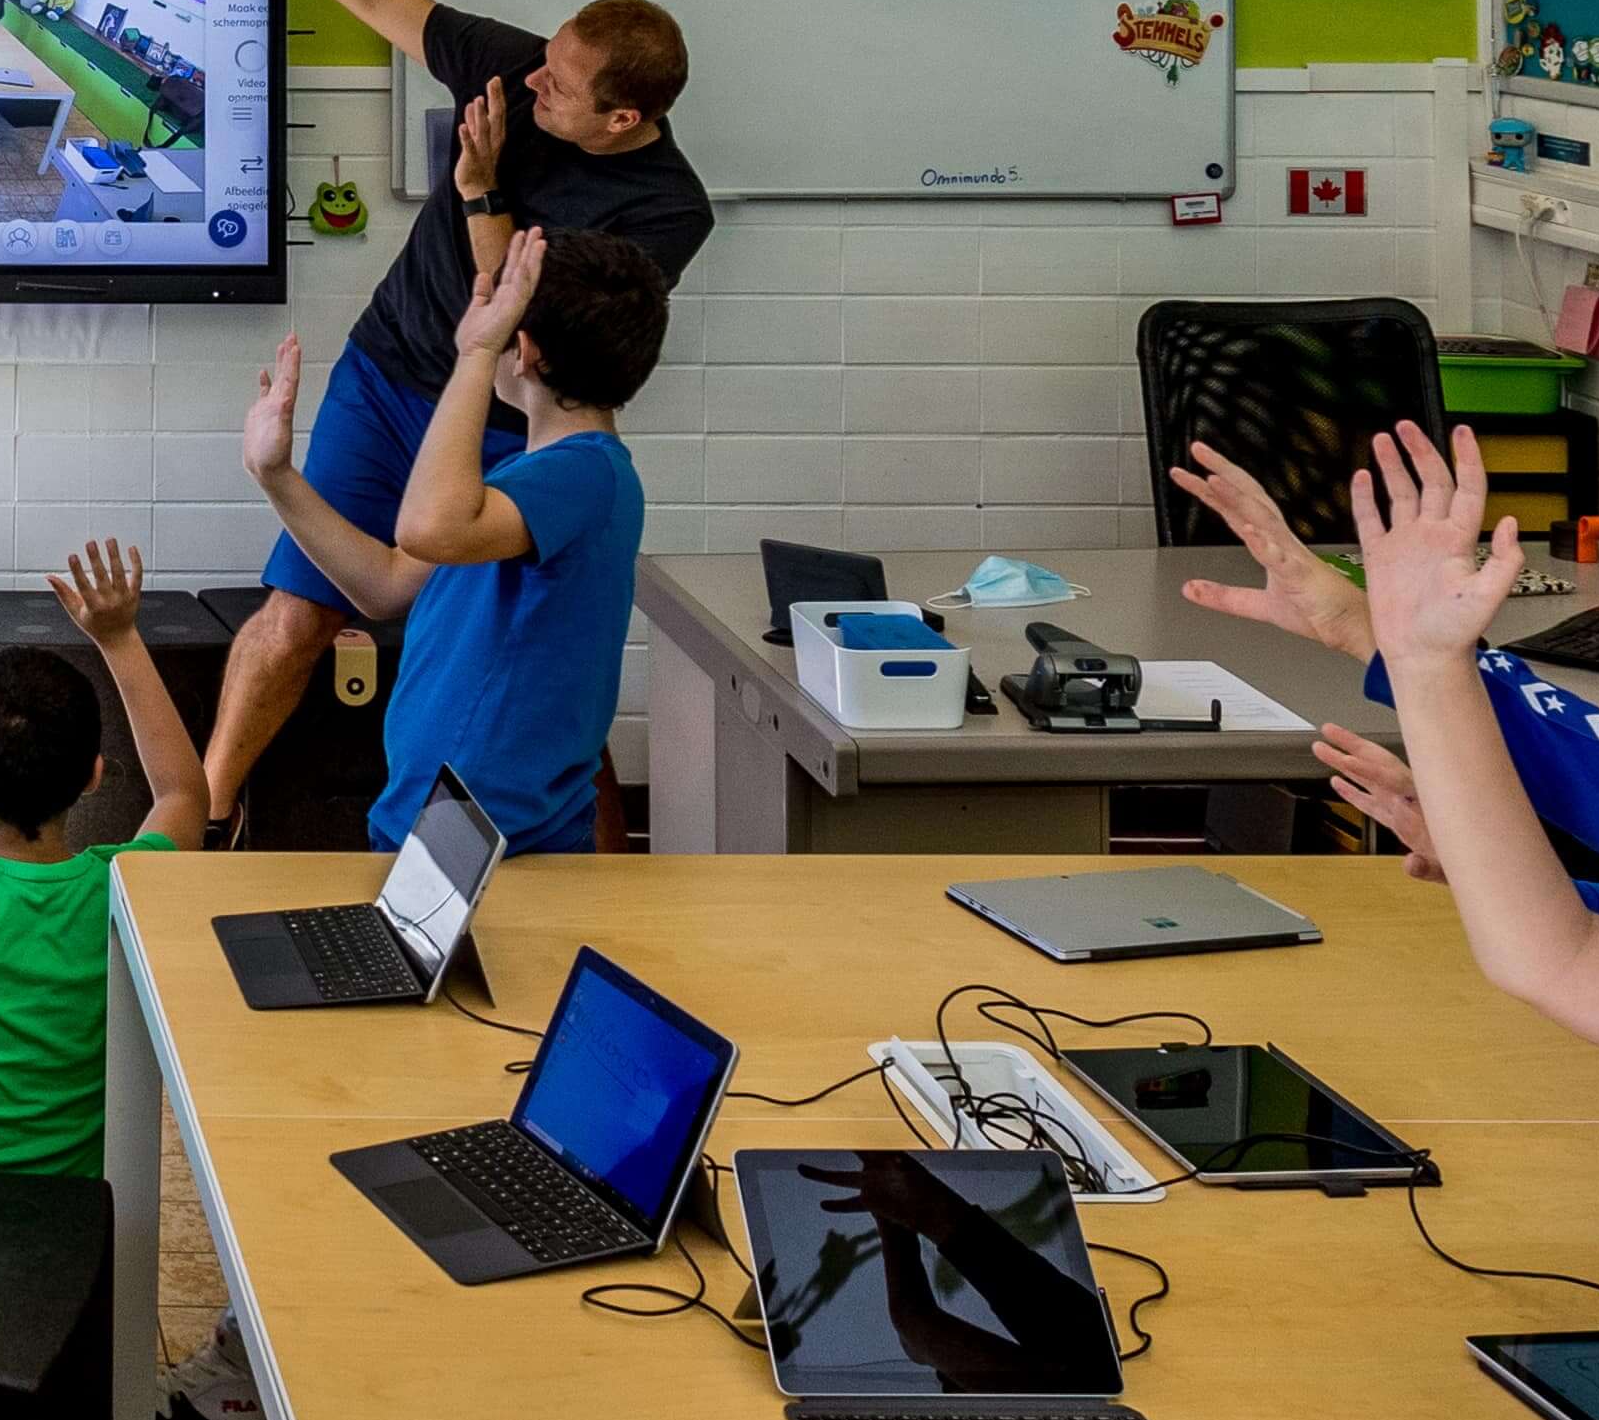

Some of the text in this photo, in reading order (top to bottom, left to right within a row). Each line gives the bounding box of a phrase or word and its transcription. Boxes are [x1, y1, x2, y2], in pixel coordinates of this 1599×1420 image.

[228, 3, 255, 13] Maak
[237, 78, 266, 88] Video
[921, 167, 1006, 186] Omnimundo
[220, 1400, 257, 1413] FILA
